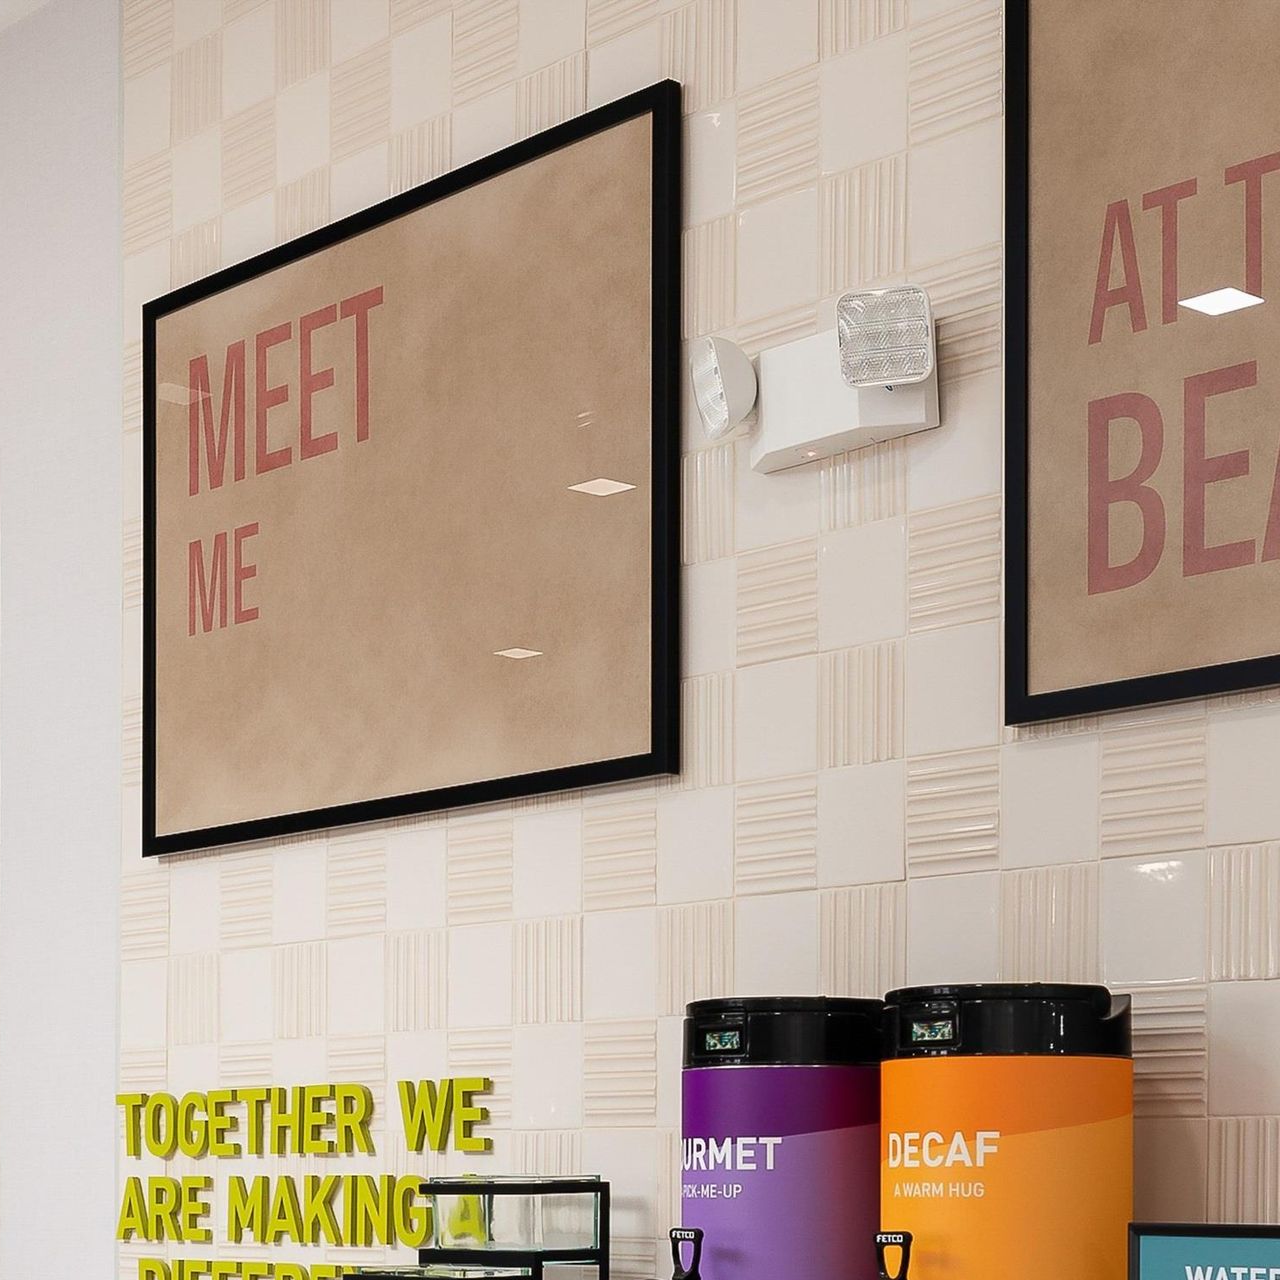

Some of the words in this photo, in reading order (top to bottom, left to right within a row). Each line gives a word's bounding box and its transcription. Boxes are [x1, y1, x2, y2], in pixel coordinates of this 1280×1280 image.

[1088, 177, 1198, 346] AT
[188, 285, 384, 497] MEET
[188, 522, 260, 637] ME
[116, 1083, 376, 1159] TOGETHER
[397, 1076, 493, 1154] WE
[681, 1137, 782, 1171] URMET
[888, 1131, 1000, 1168] DECAF
[116, 1174, 213, 1242] ARE
[227, 1174, 434, 1248] MAKING
[894, 1183, 901, 1197] A
[903, 1183, 944, 1197] WARM
[949, 1182, 985, 1197] HUG
[672, 1231, 695, 1239] FETCO
[876, 1234, 904, 1243] FETCO
